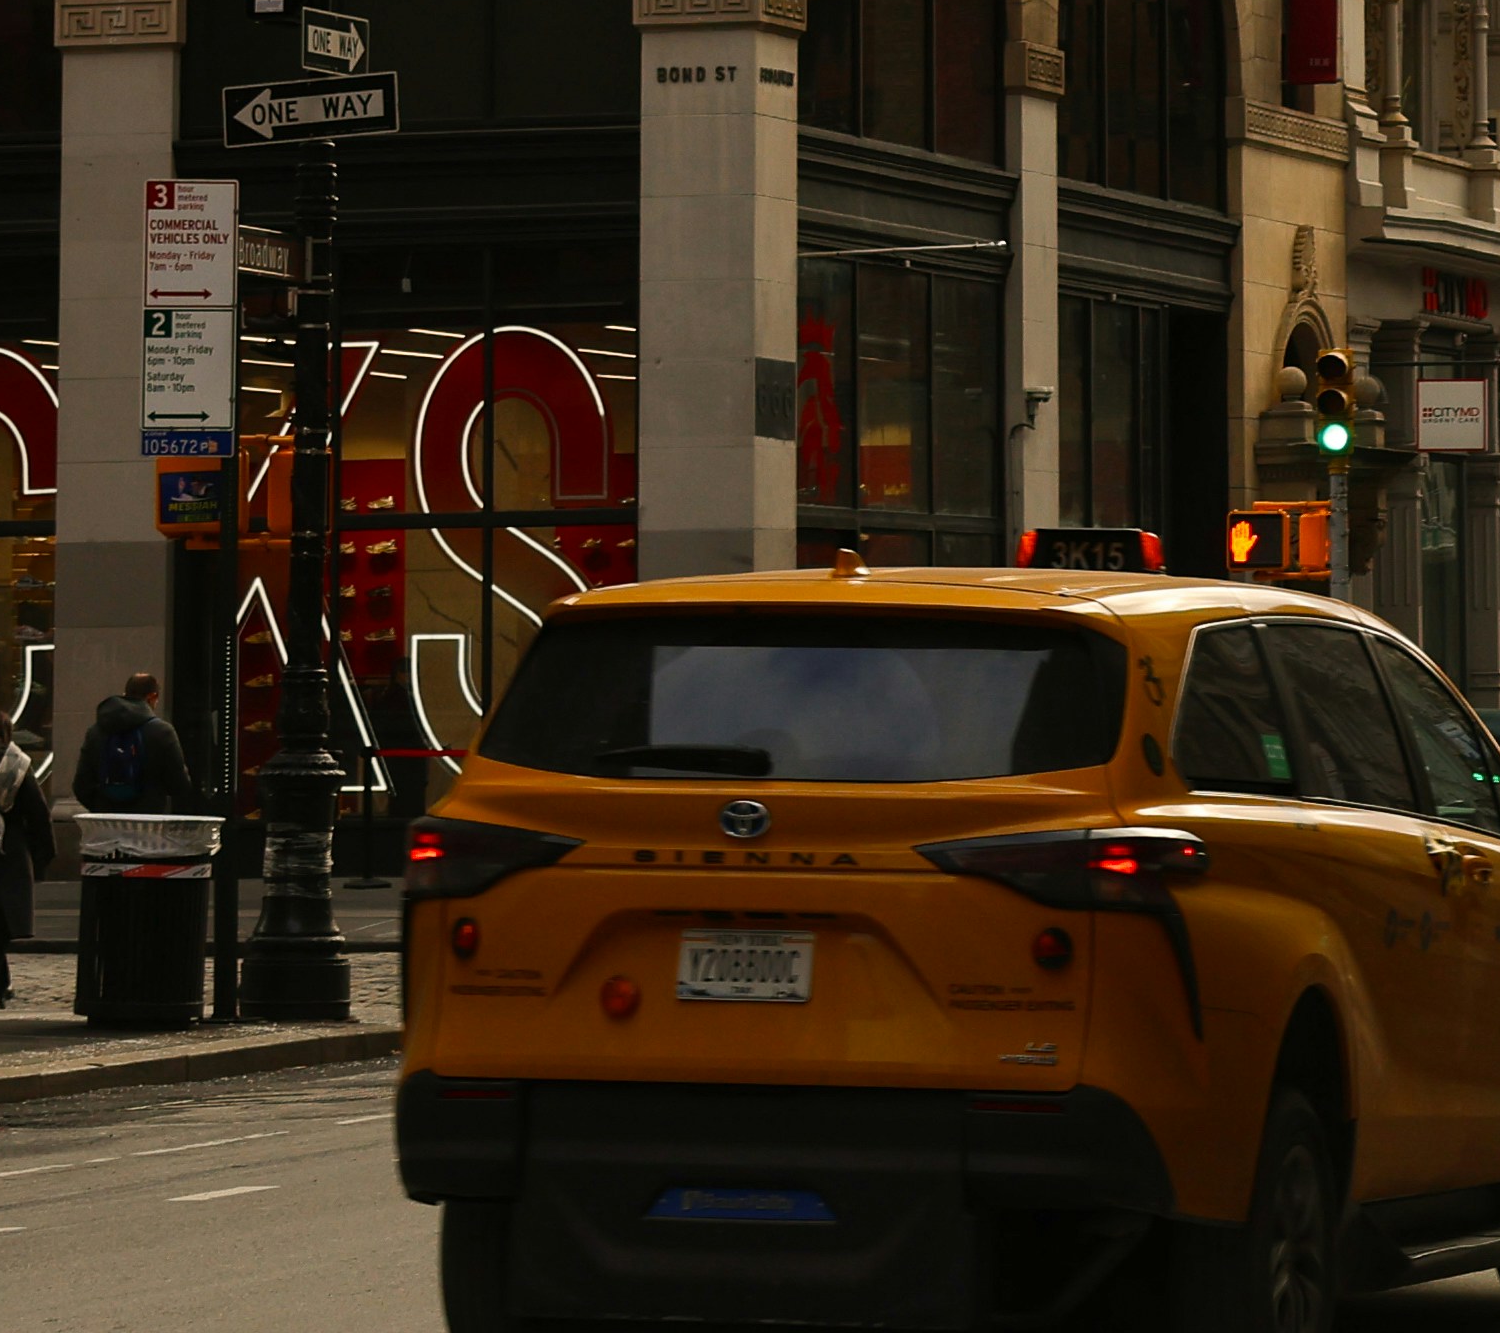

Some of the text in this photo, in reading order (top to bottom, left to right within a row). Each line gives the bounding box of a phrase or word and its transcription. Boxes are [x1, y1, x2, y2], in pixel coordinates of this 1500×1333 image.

[312, 29, 358, 59] ONE WAY
[656, 66, 736, 83] BOND ST
[252, 94, 372, 126] ONE WAY
[153, 183, 168, 208] 3
[149, 220, 218, 230] COMMERCIAL
[150, 234, 229, 244] VEHICLES ONLY
[149, 251, 215, 261] Monday Friday
[238, 235, 289, 270] Broadway
[149, 263, 193, 272] 7am 6pm
[151, 312, 166, 335] 2
[175, 331, 202, 339] parking
[147, 345, 213, 355] Monday Friday
[147, 356, 195, 367] 6pm 10pm
[147, 372, 184, 382] Saturday
[147, 383, 195, 393] 8am 10pm
[1432, 407, 1480, 417] CITYMD
[144, 439, 198, 454] 105672
[1050, 541, 1125, 570] 3K15
[635, 848, 858, 866] SIENNA
